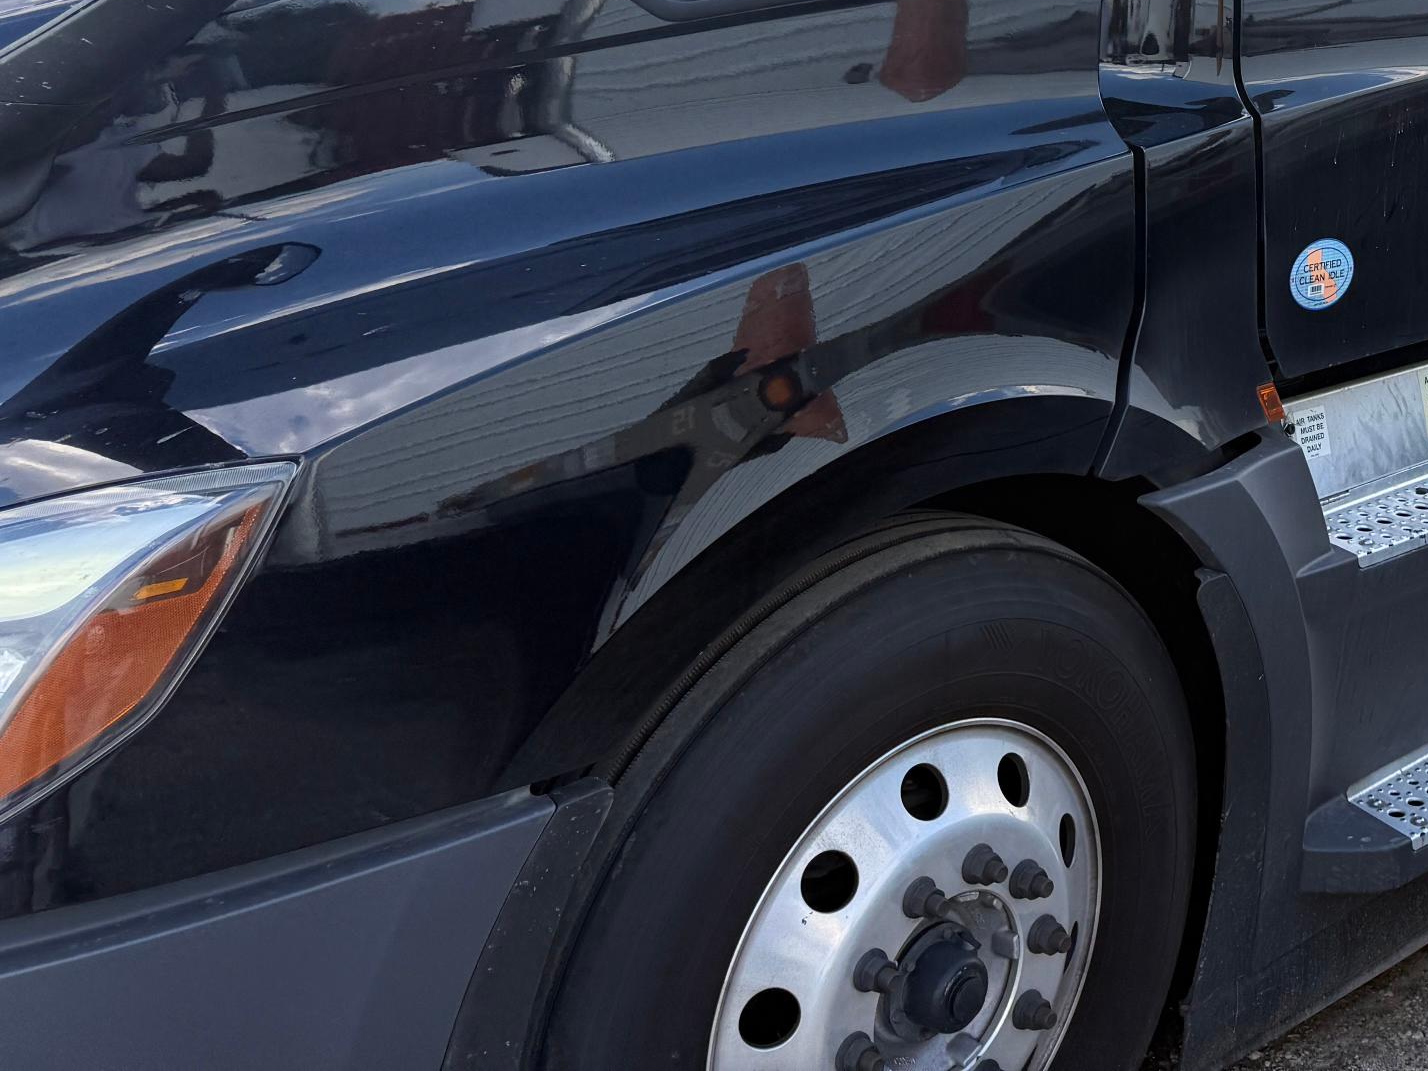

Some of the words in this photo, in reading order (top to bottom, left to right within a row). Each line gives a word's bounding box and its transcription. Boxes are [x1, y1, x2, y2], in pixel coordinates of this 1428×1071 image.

[1303, 259, 1342, 273] CERTIFIED
[1299, 273, 1325, 285] CLEAN
[1329, 269, 1344, 280] IDLE
[1296, 417, 1305, 425] AIR
[1307, 412, 1325, 422] TANKS
[1300, 424, 1316, 435] MUST
[1316, 422, 1325, 430] BE
[1301, 432, 1325, 444] DRAINED
[1306, 443, 1321, 453] DAILY
